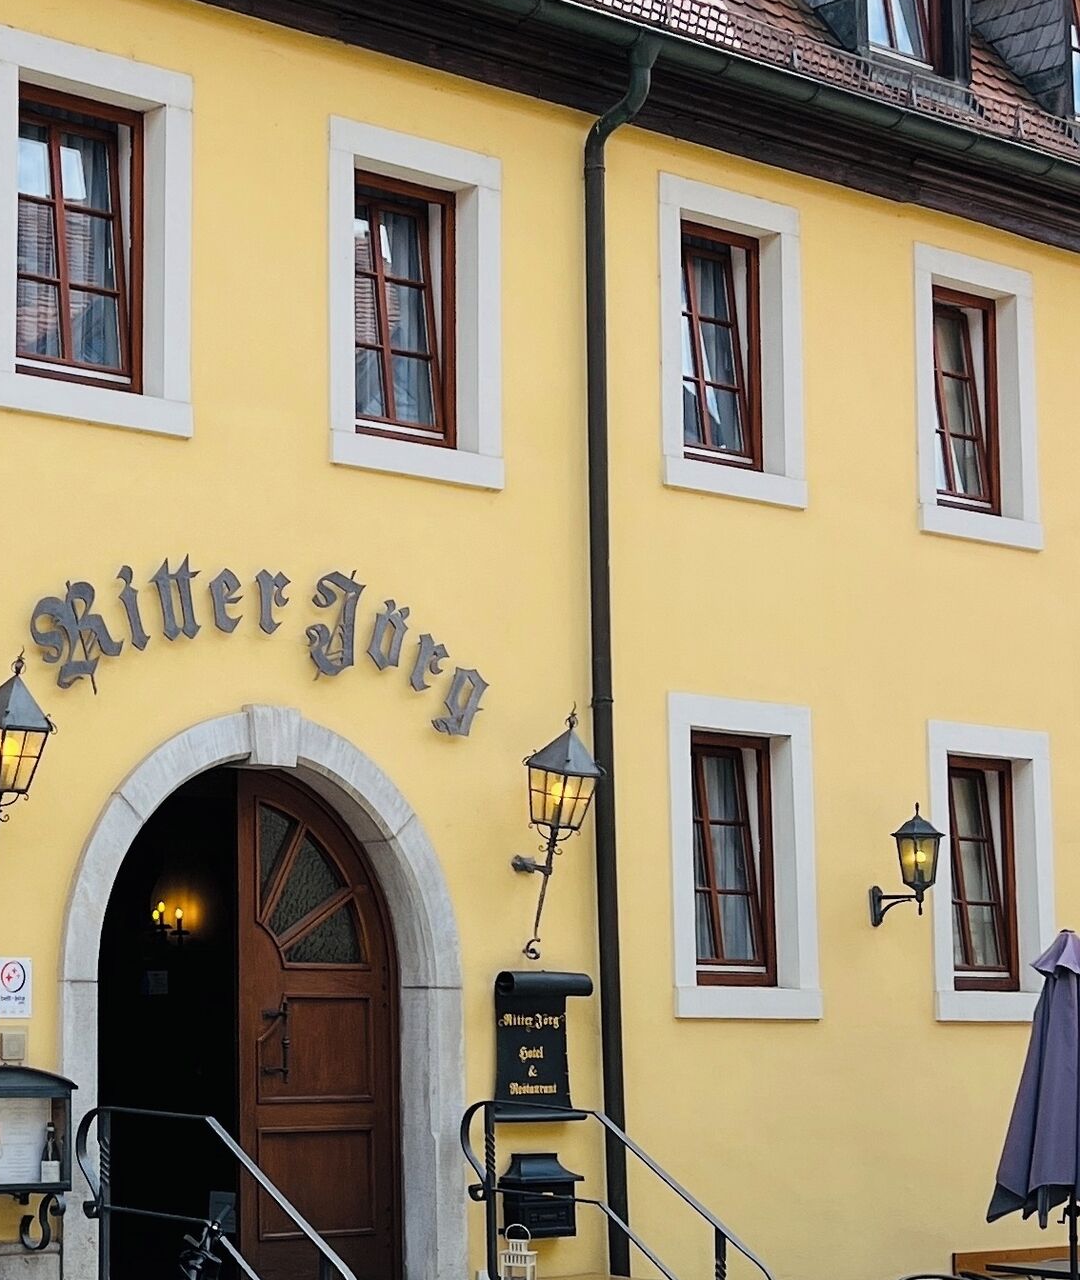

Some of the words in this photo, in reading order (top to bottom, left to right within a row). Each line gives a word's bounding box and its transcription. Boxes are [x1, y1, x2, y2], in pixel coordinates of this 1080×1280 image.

[30, 554, 292, 694] Ritter
[306, 570, 490, 736] Jörg
[499, 1013, 534, 1028] Ritter
[519, 1046, 544, 1061] Hotel
[528, 1065, 538, 1077] &
[509, 1082, 557, 1095] Restaurant
